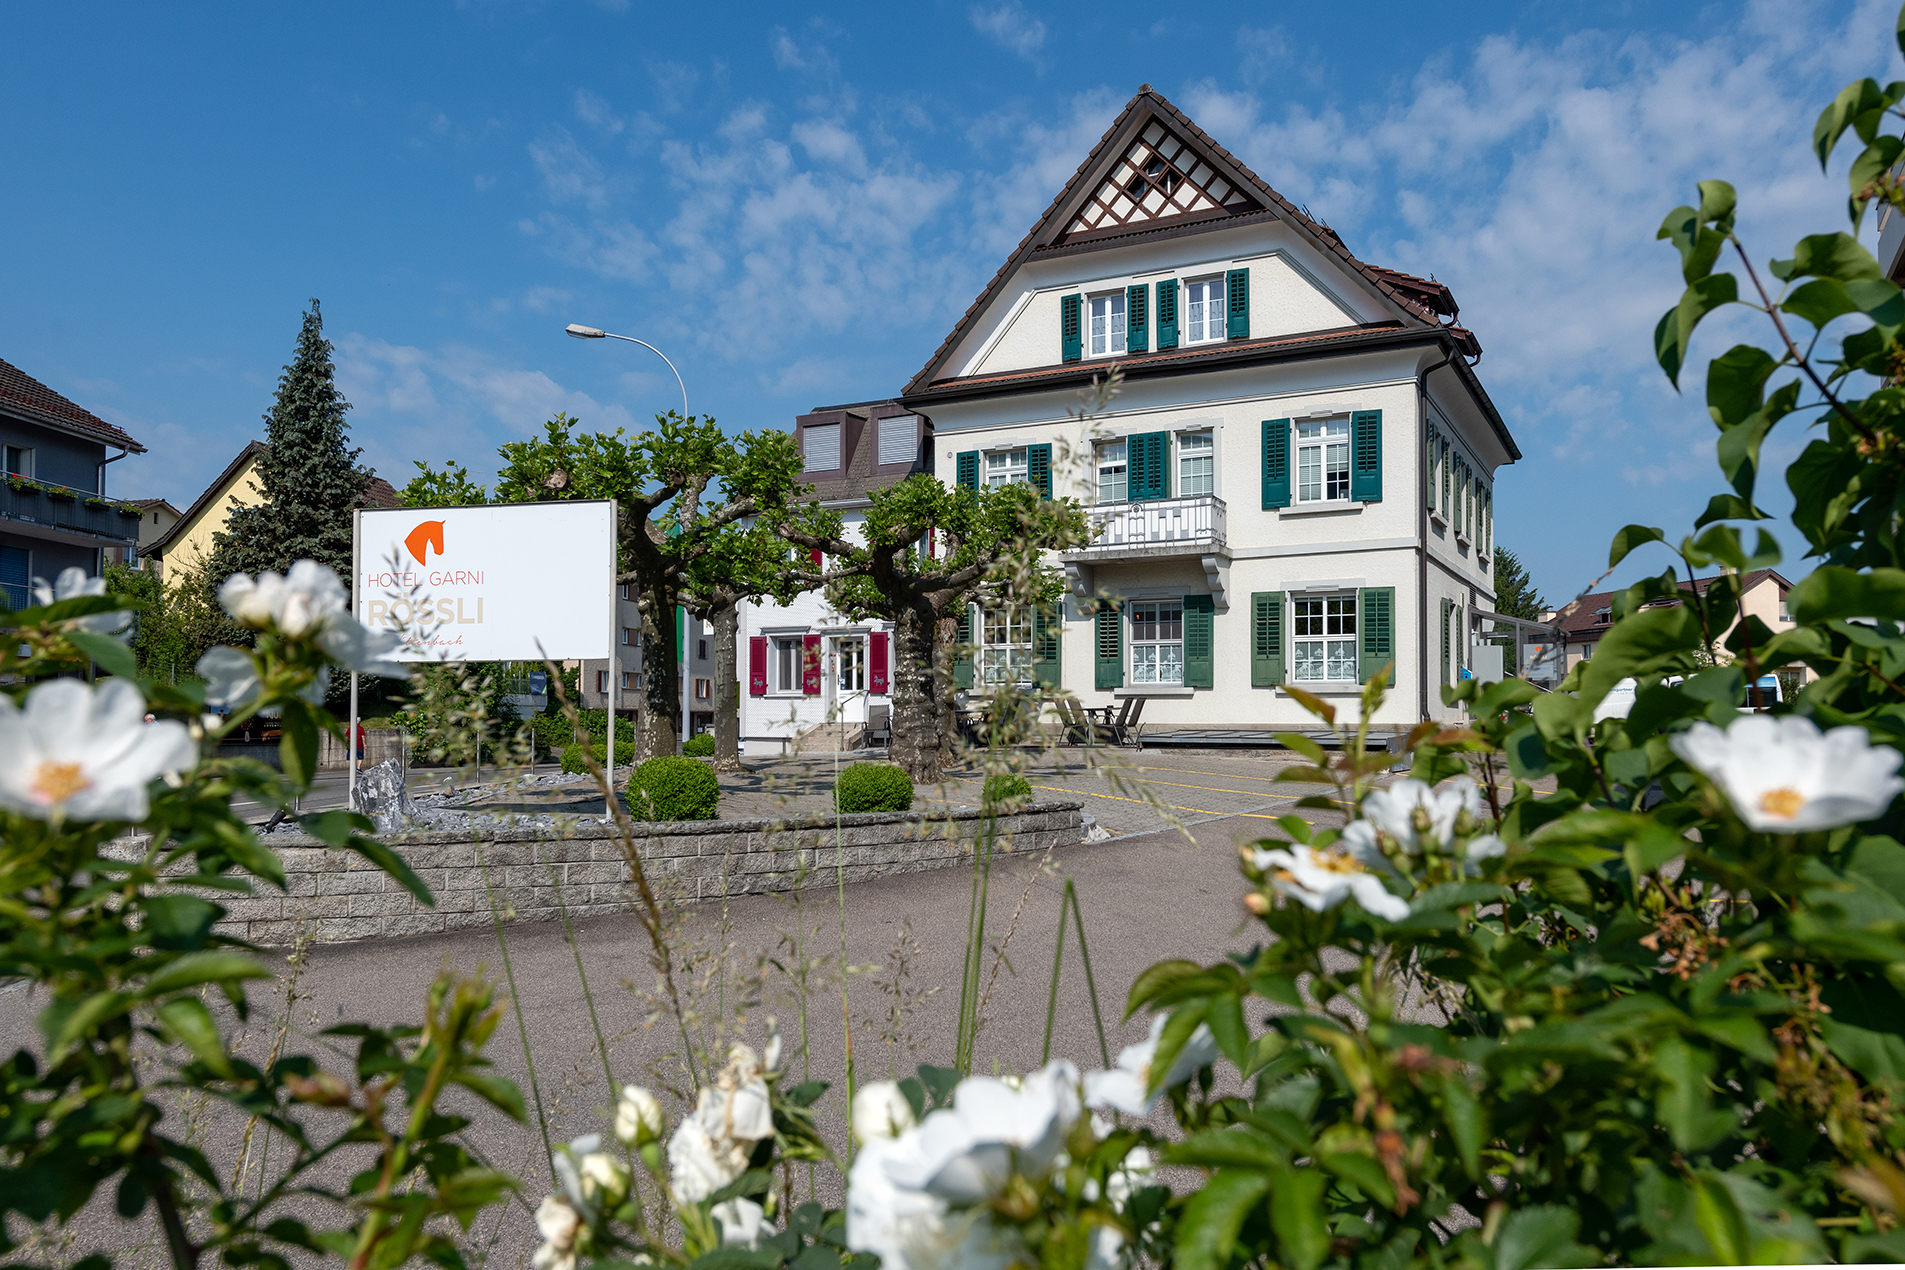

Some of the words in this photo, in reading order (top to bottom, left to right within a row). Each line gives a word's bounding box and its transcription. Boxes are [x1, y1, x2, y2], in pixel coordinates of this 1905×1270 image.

[368, 572, 423, 588] HOTEL
[429, 570, 484, 587] GARNI
[368, 592, 484, 627] RÖSSLI
